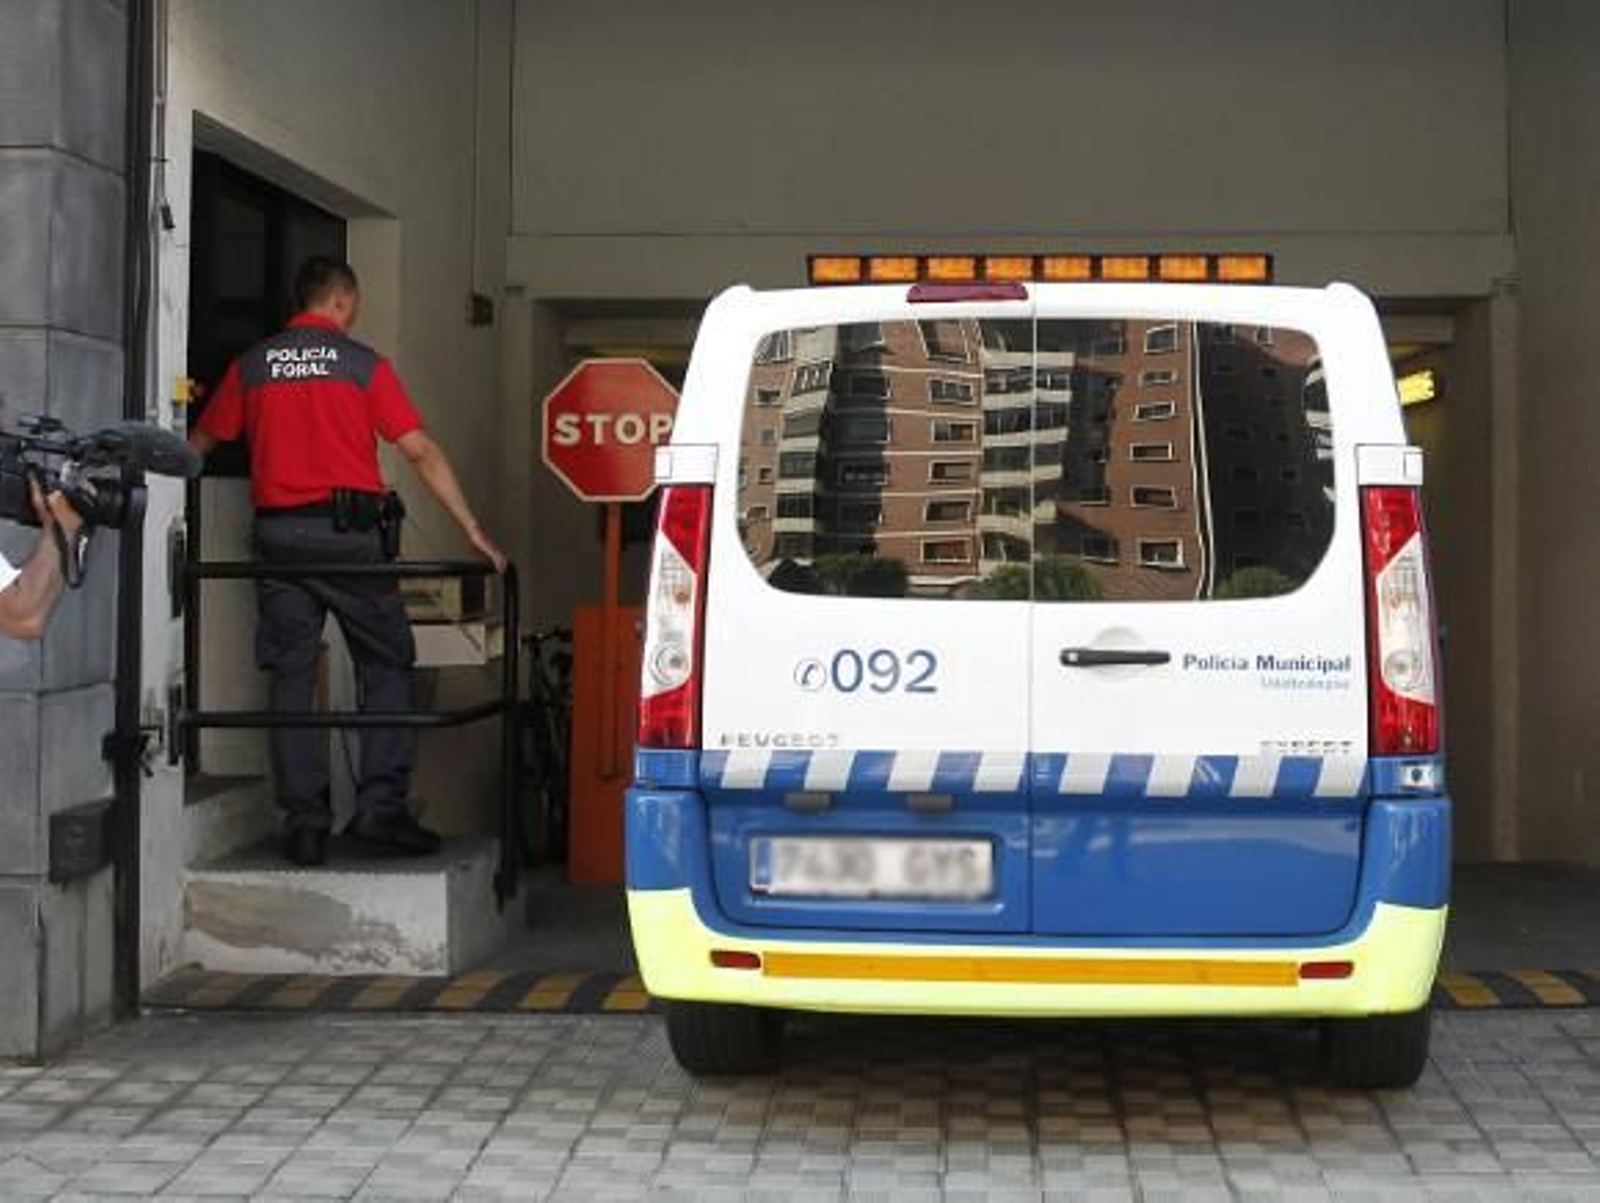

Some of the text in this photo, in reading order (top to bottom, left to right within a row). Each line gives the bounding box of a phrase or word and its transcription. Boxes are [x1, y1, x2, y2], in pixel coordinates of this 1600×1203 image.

[271, 362, 330, 378] FORAL
[552, 414, 673, 444] STOP
[831, 649, 937, 693] 092
[1256, 655, 1351, 674] Municipal
